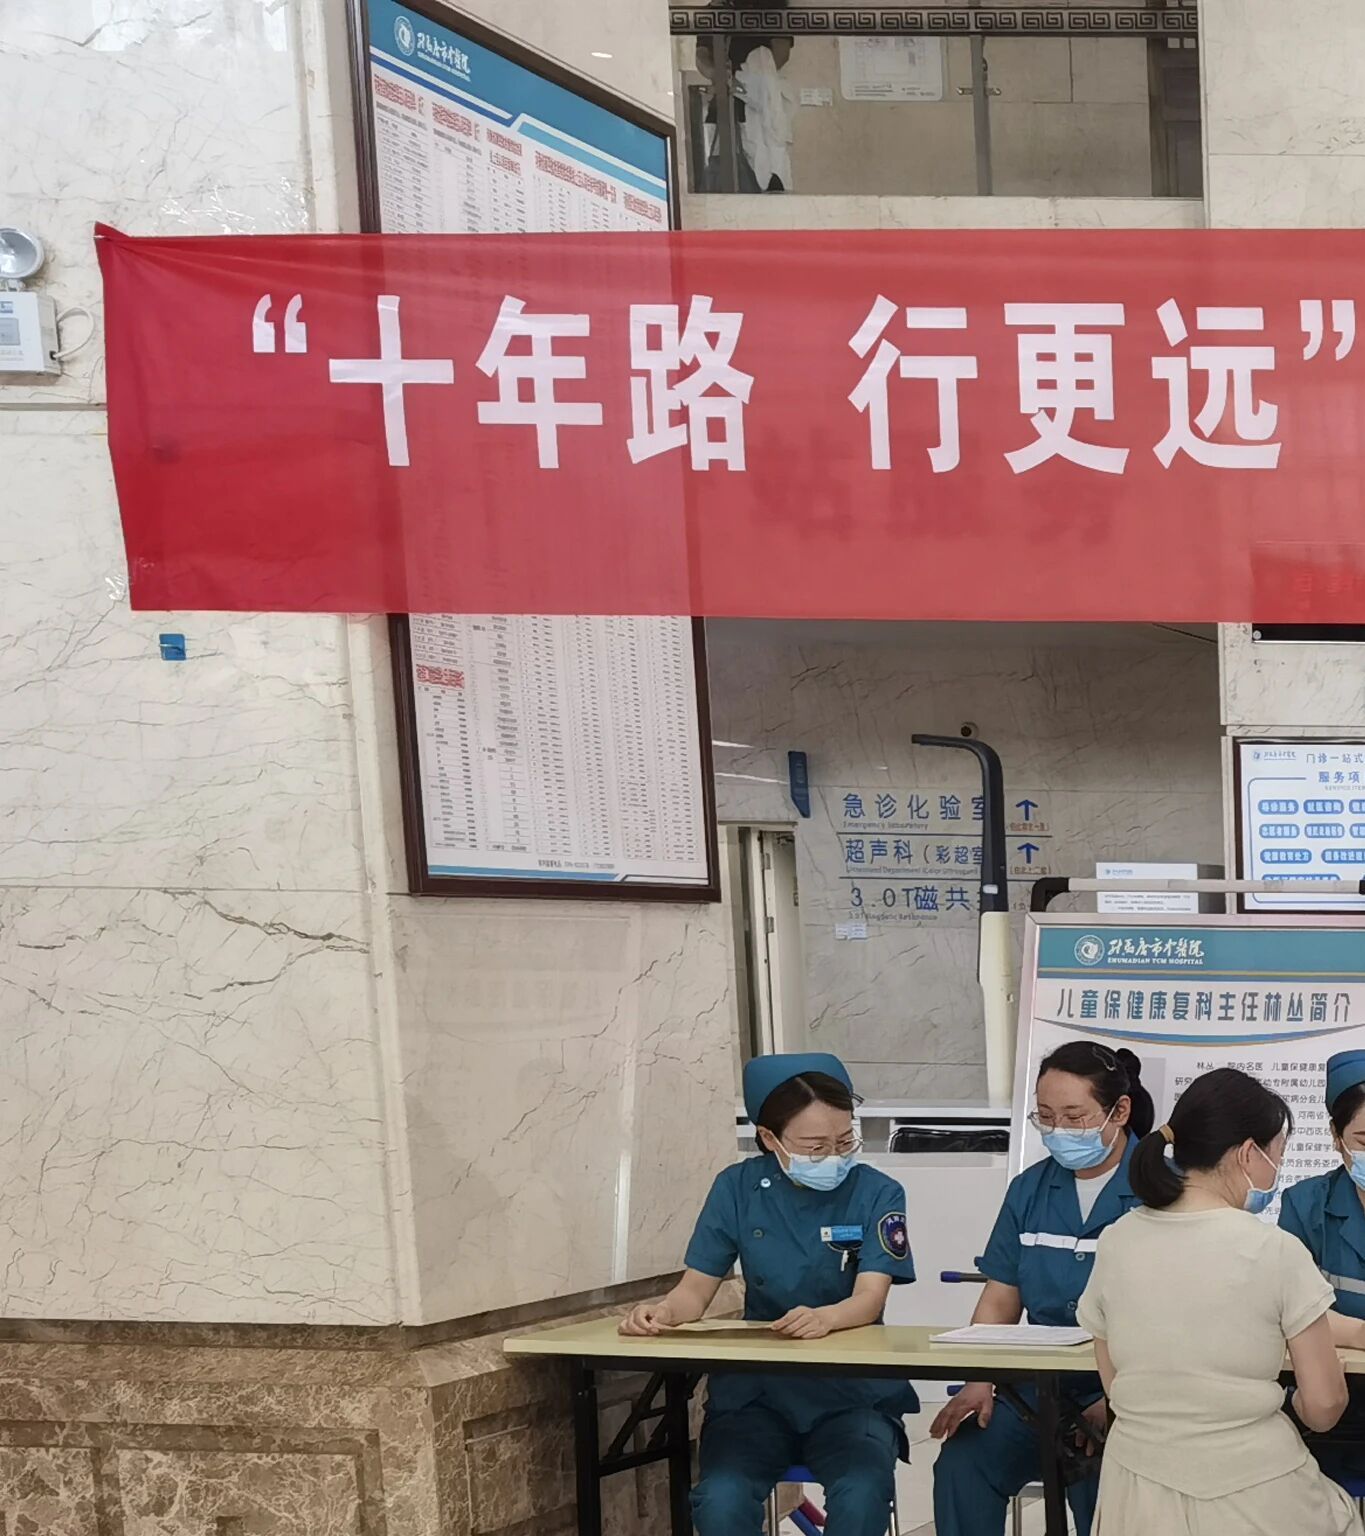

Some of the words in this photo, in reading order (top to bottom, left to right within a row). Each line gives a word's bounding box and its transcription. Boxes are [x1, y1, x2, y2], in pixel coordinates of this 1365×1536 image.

[252, 293, 755, 472] “十年路
[848, 293, 1357, 475] 行更远”
[850, 884, 984, 912] 3.0T磁共
[1056, 988, 1351, 1023] 儿童保健康复科主任林丛简介
